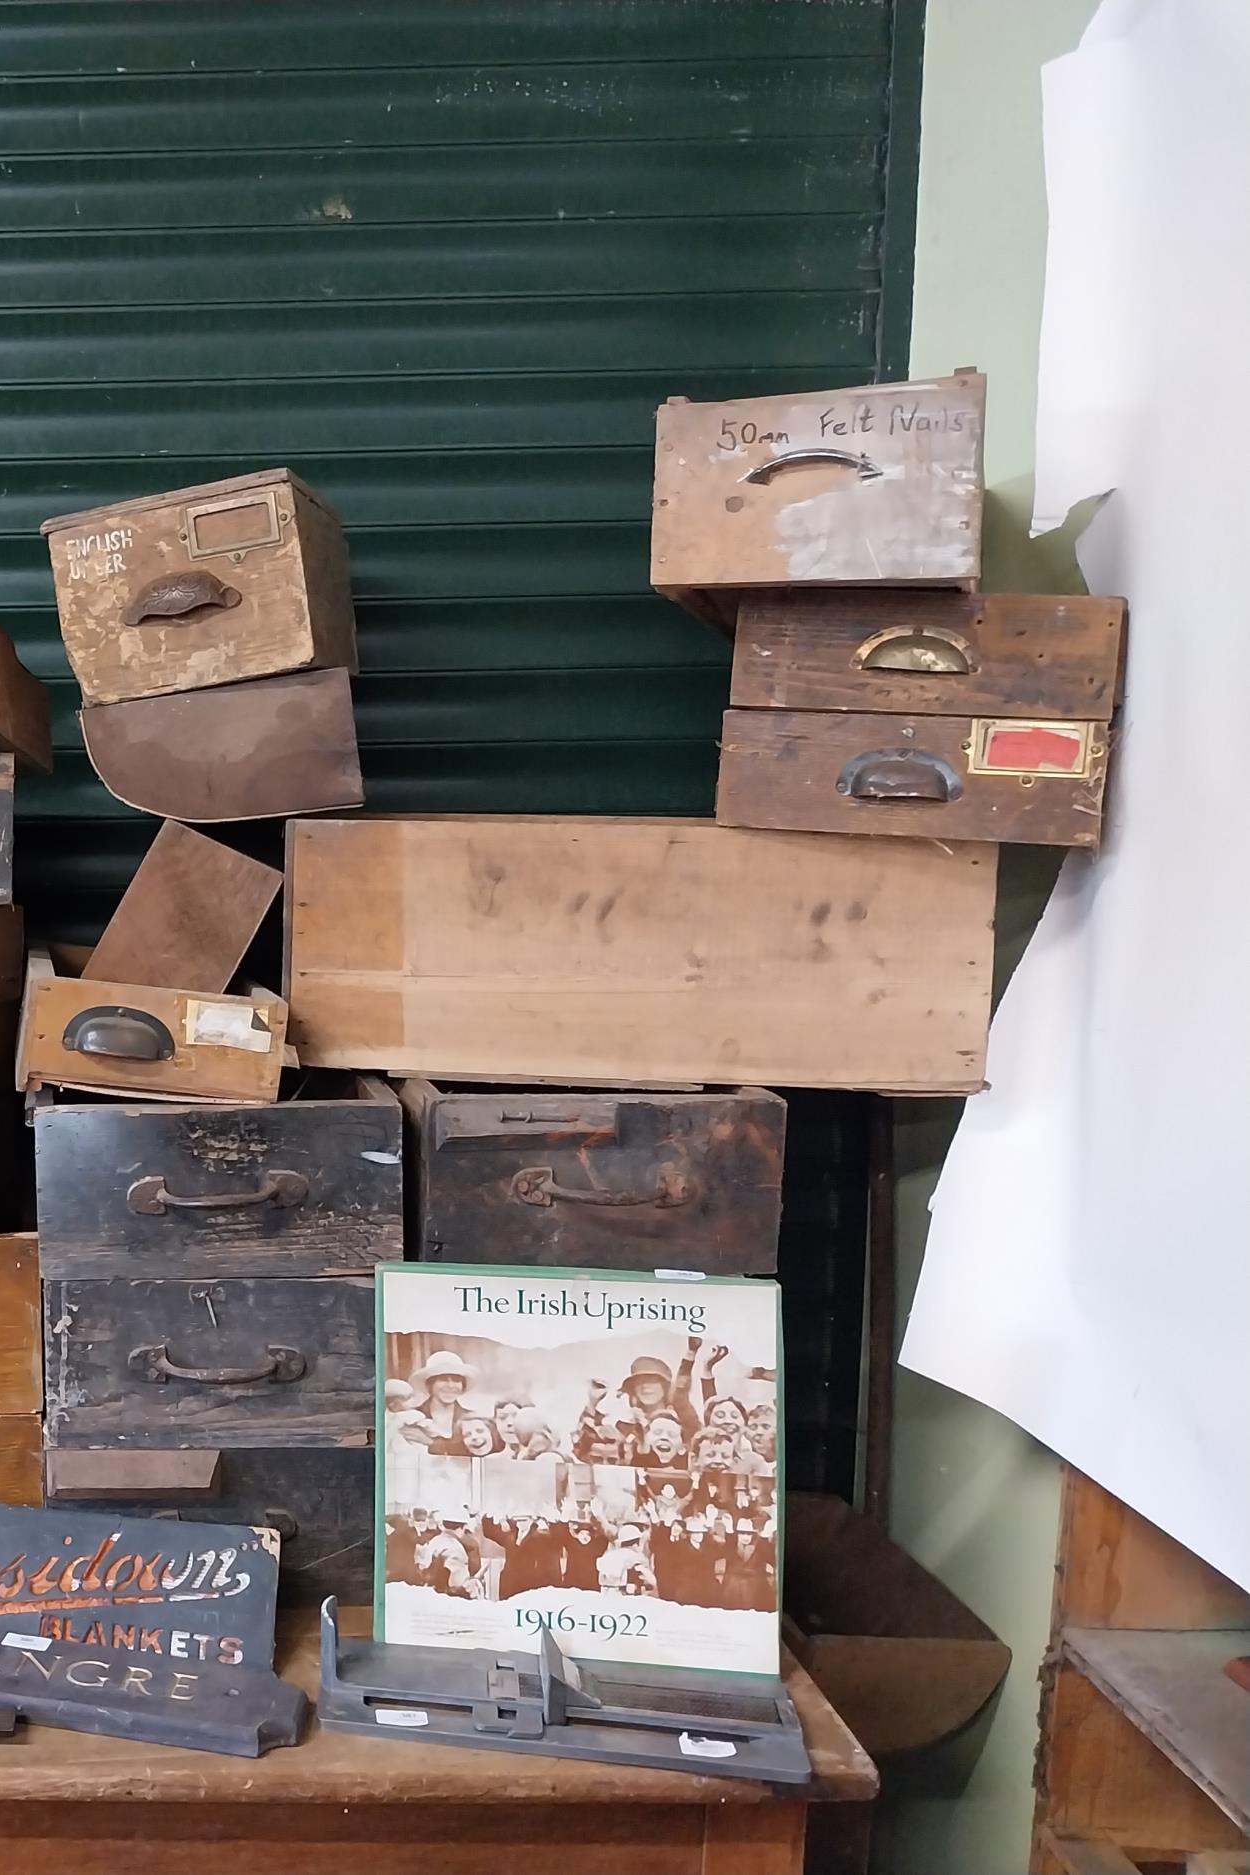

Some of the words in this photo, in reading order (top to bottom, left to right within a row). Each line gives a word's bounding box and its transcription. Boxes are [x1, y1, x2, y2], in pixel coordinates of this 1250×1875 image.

[818, 408, 876, 438] Felt
[889, 403, 967, 437] Nails
[453, 1285, 510, 1316] The
[516, 1288, 578, 1319] Irish
[582, 1291, 707, 1333] Uprising
[39, 1614, 245, 1666] BLANKETS
[514, 1604, 650, 1641] 1916-1922
